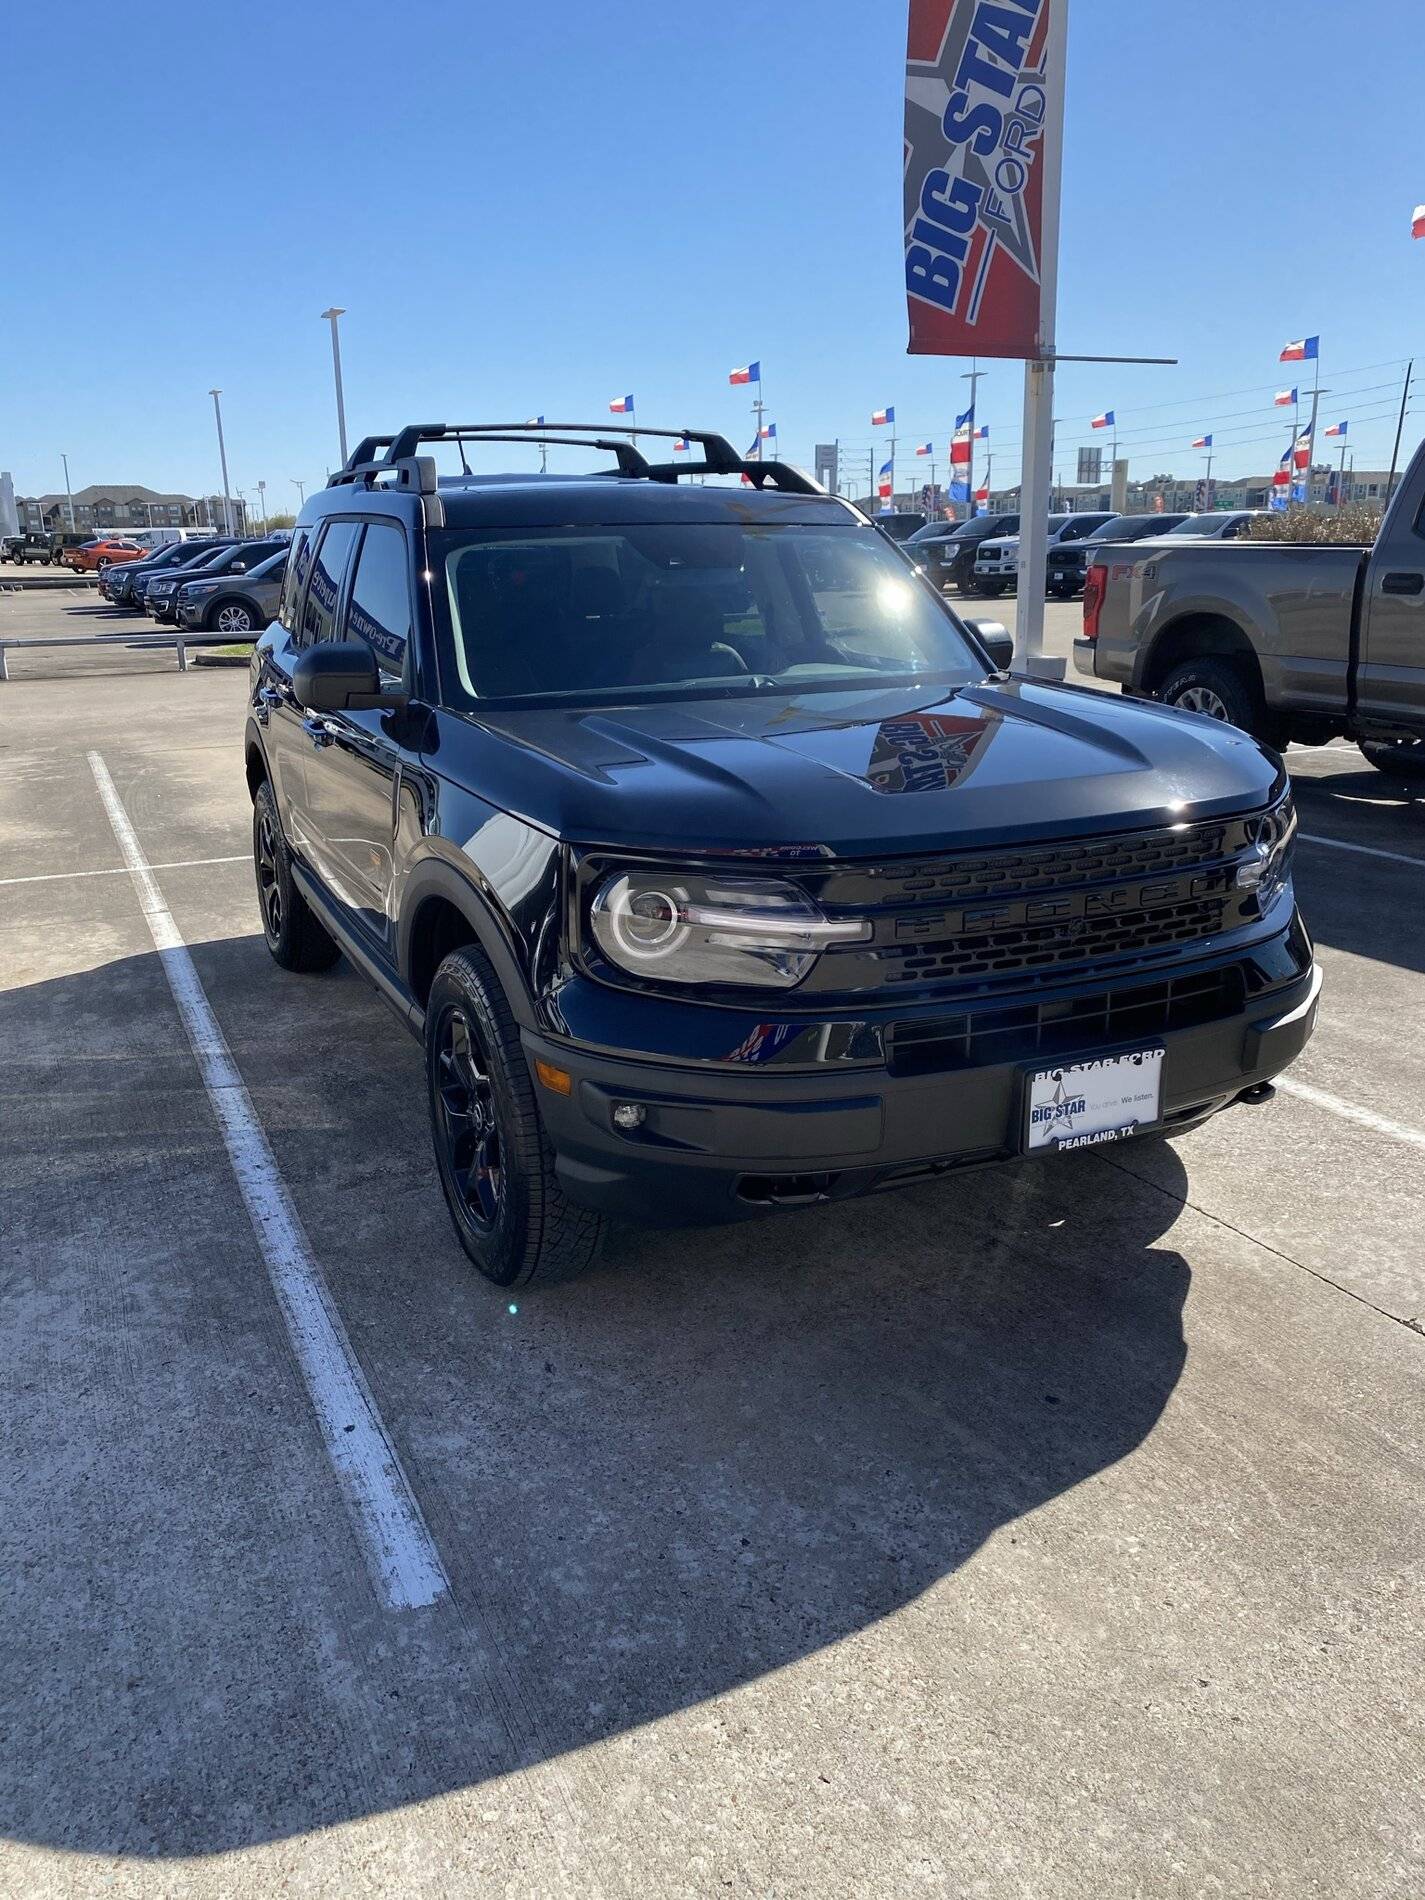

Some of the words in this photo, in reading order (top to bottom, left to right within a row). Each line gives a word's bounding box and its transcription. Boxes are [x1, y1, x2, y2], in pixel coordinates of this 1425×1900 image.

[985, 84, 1048, 224] FORD
[906, 167, 984, 311] BIG
[1111, 563, 1159, 581] FX4
[1033, 1067, 1066, 1081] BIG
[1119, 1048, 1166, 1065] FORD
[1032, 1108, 1052, 1124] BIG
[1055, 1100, 1086, 1119] STAR
[1121, 1095, 1133, 1104] We
[1058, 1128, 1118, 1151] PEARLAND,
[1120, 1125, 1135, 1136] TX
